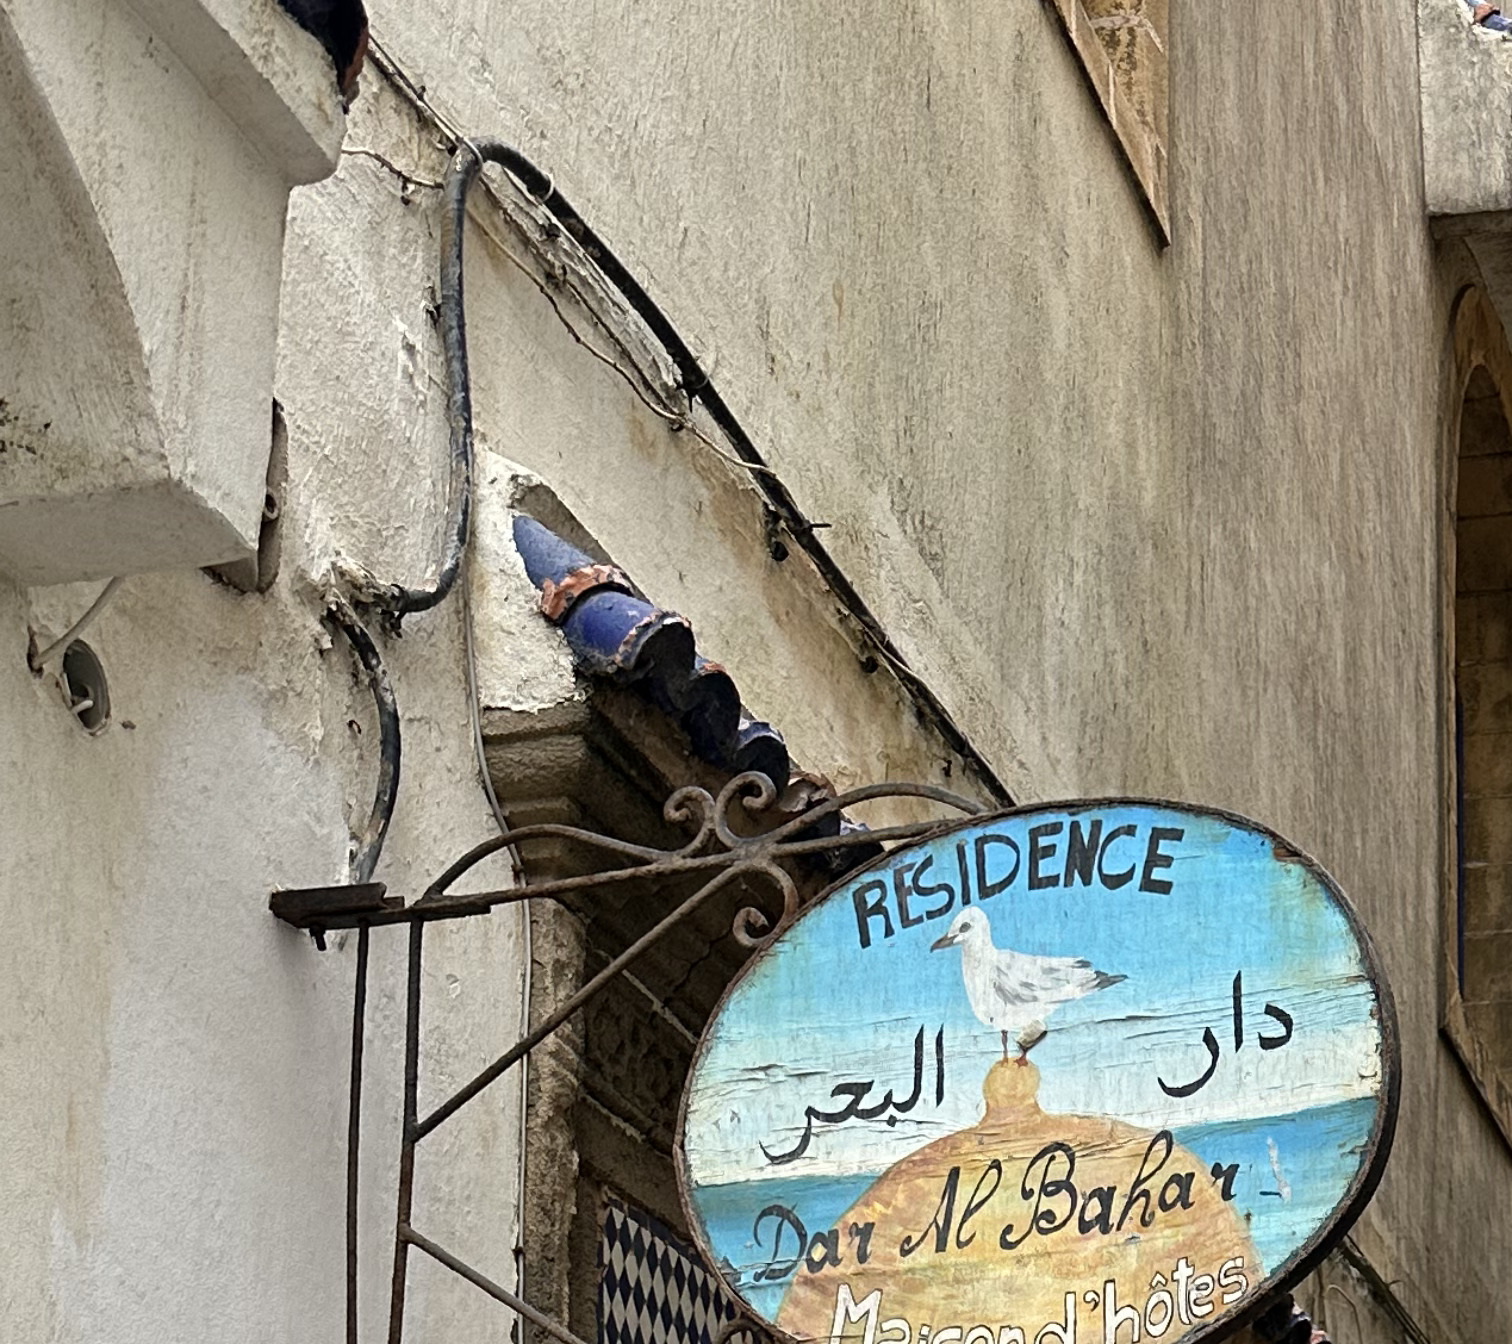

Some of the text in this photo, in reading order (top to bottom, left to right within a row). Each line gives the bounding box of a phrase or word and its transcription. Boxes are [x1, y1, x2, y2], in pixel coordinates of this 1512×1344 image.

[852, 819, 1185, 949] RESIDENCE
[758, 969, 1294, 1165] دار البحر
[753, 1128, 1242, 1283] Dar Al Bahar
